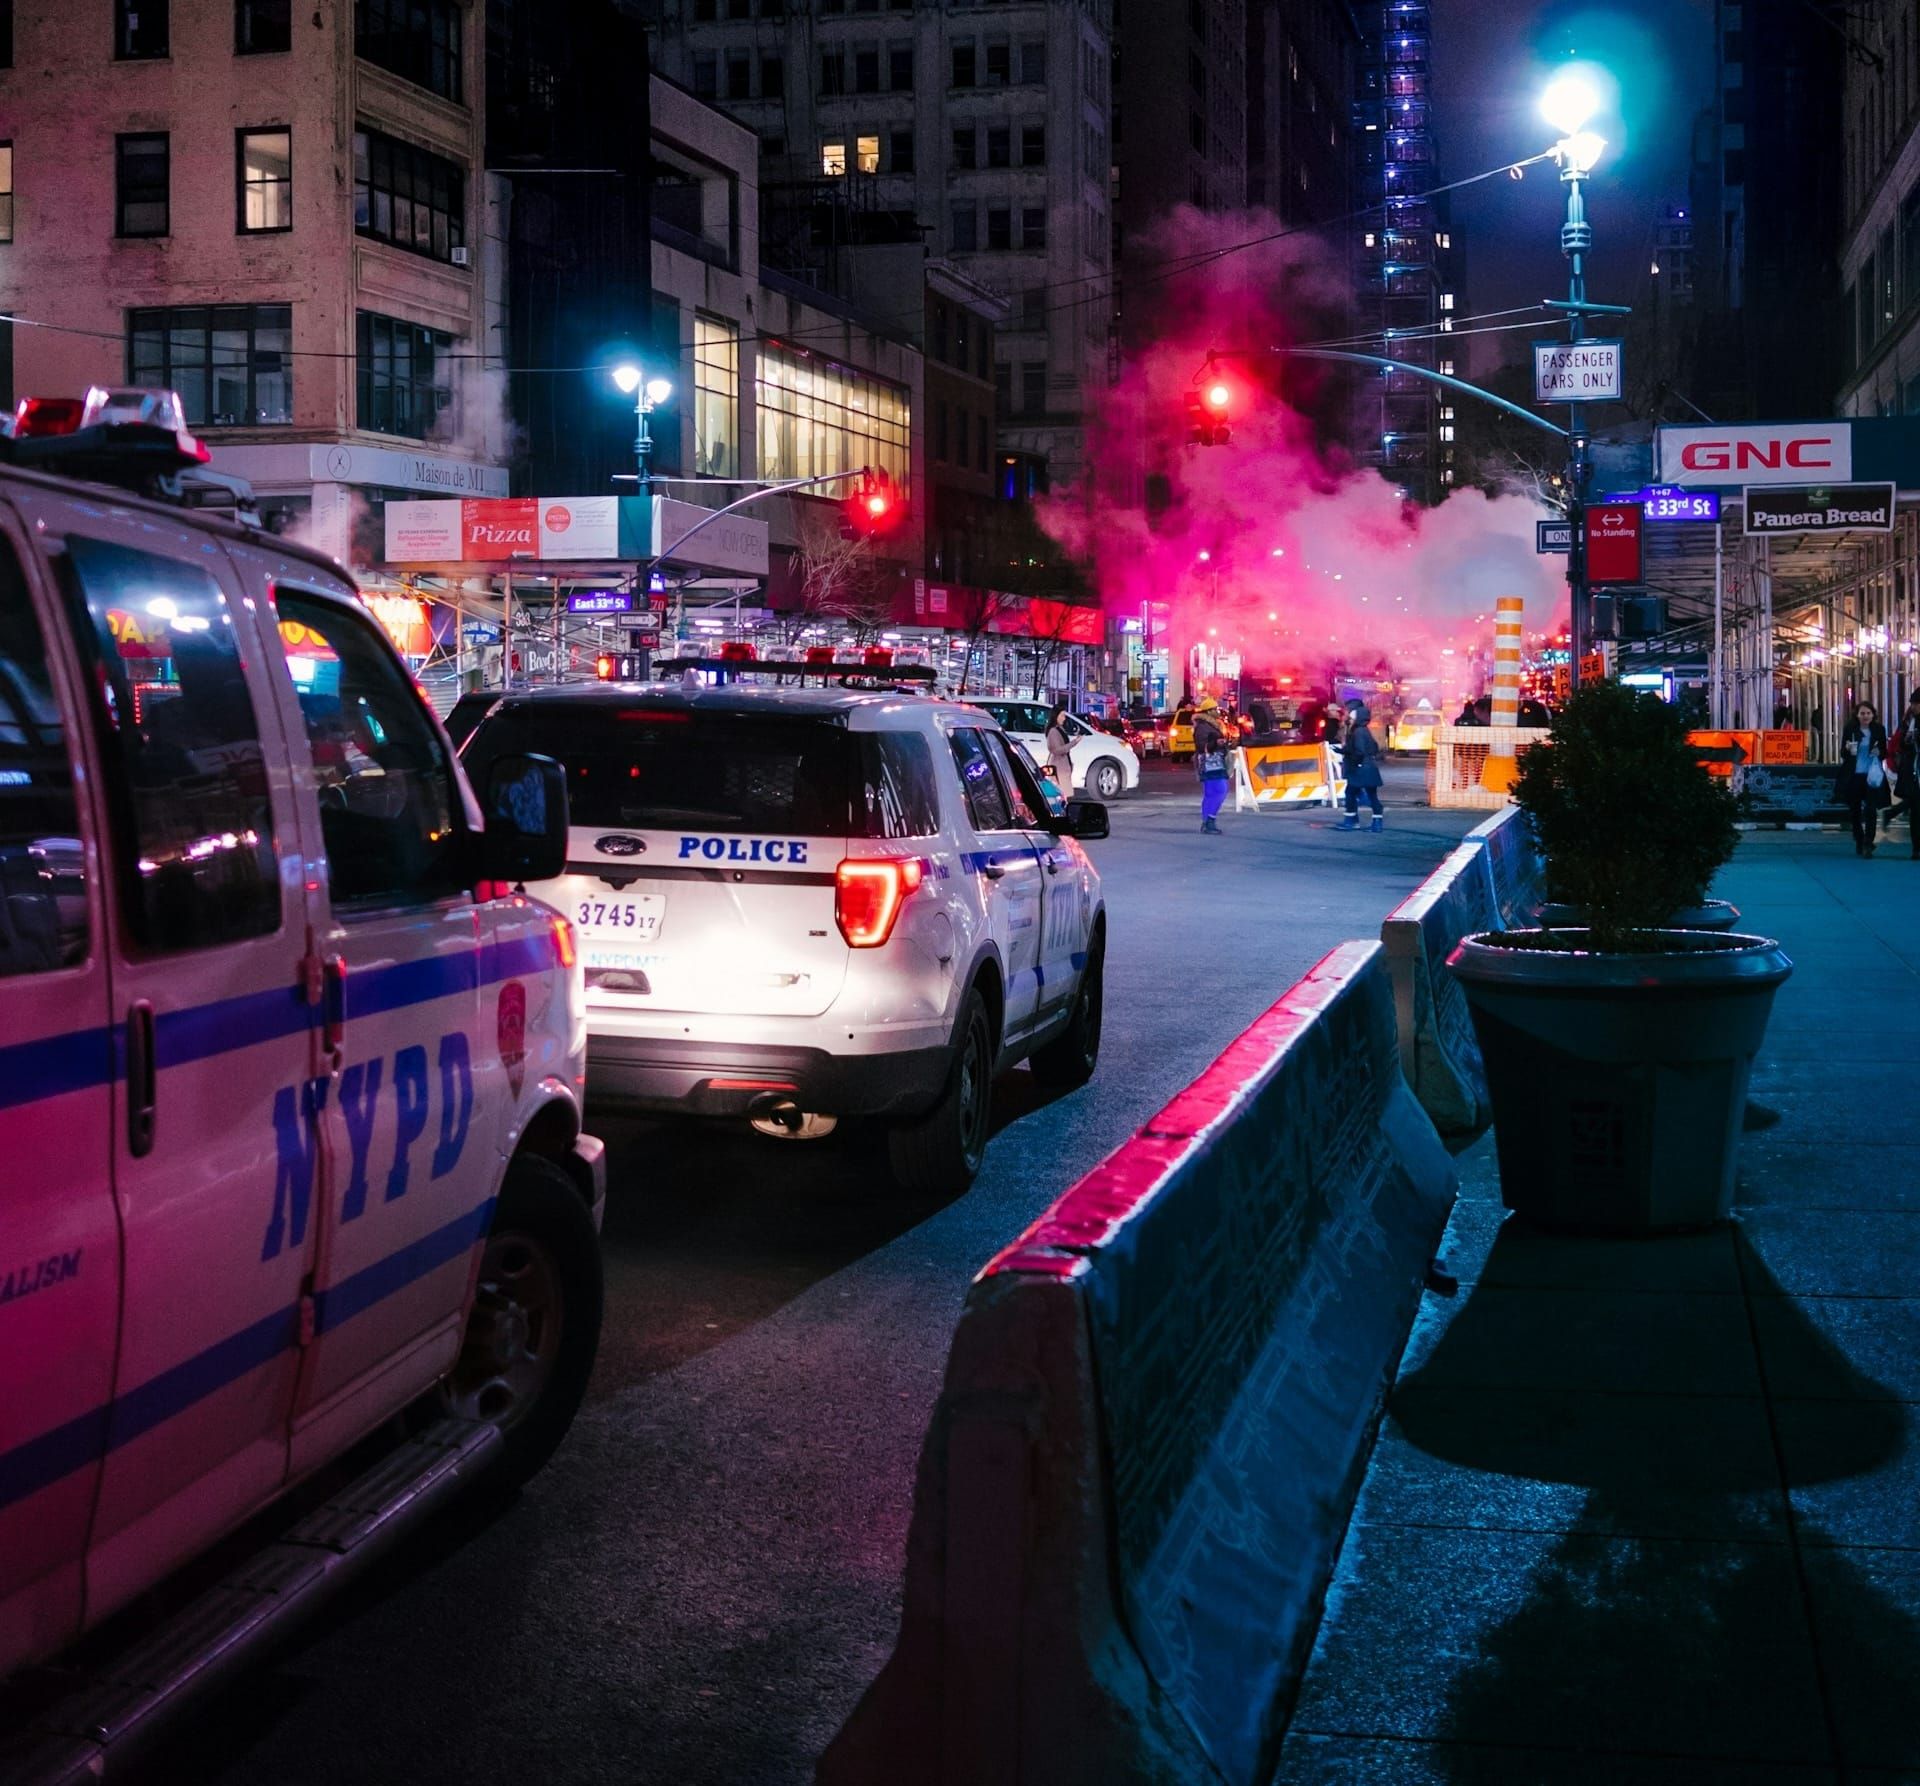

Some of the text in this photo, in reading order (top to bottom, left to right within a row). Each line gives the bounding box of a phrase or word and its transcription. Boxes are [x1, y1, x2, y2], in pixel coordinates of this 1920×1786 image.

[1543, 351, 1614, 369] PASSENGER
[1543, 372, 1613, 390] CARS ONLY
[1682, 439, 1832, 470] GNC
[415, 462, 450, 485] Maison
[453, 466, 465, 488] de
[1658, 498, 1689, 515] 33rd
[1693, 499, 1711, 515] St
[1753, 508, 1885, 527] Panera Bread
[470, 524, 531, 544] Pizza
[1591, 528, 1635, 537] No Standing
[575, 597, 625, 609] East 33rd St
[678, 837, 808, 863] POLICE
[578, 903, 656, 928] 3745 17
[260, 1031, 475, 1264] NYPD
[0, 1247, 83, 1305] ALISM
